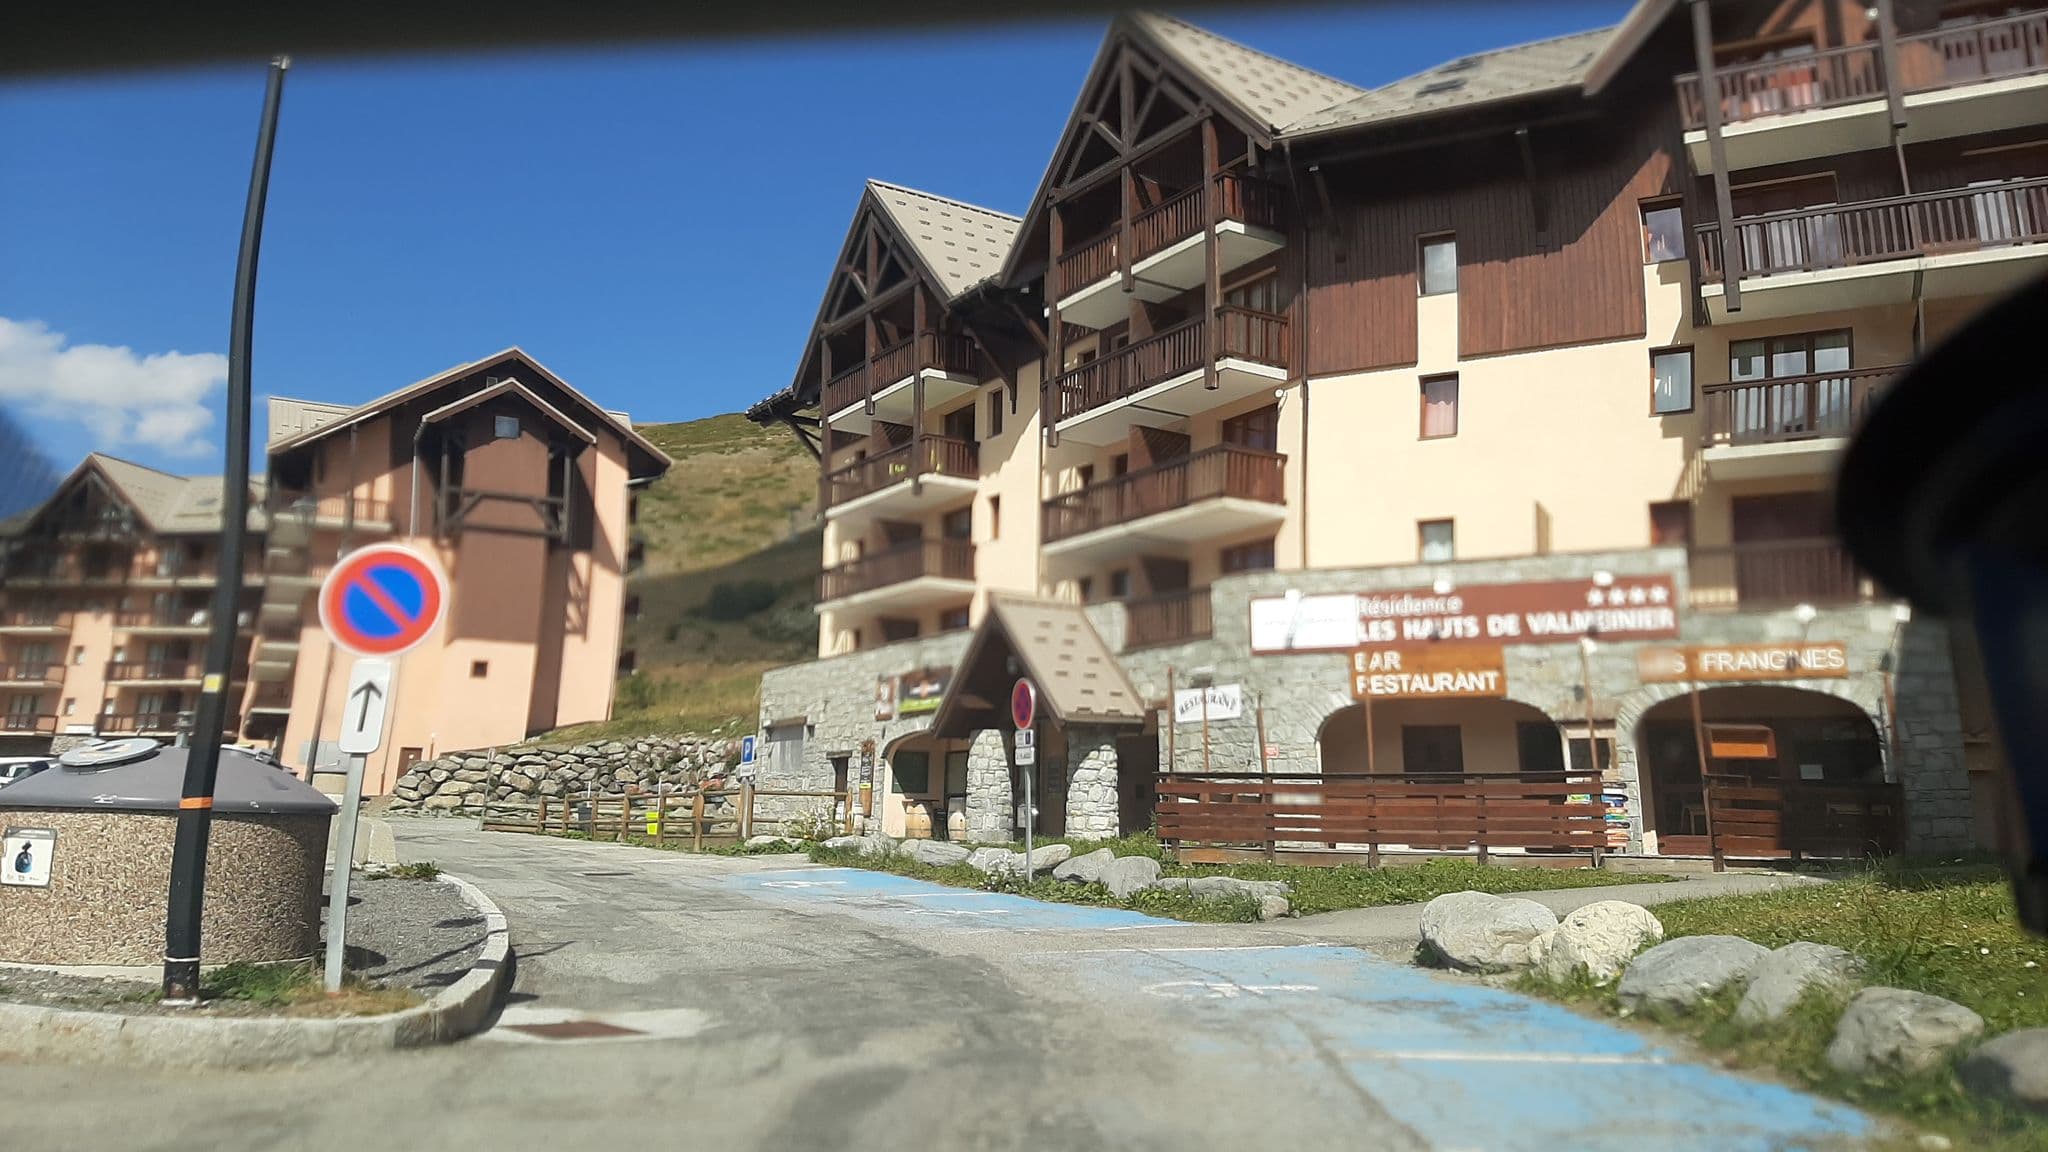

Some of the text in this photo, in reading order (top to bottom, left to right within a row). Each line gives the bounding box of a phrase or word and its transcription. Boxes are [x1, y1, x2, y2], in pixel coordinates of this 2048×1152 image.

[1358, 619, 1397, 641] LES
[1403, 615, 1480, 640] HAUTS
[1486, 613, 1521, 637] DE
[1356, 670, 1499, 694] RESTAURANT
